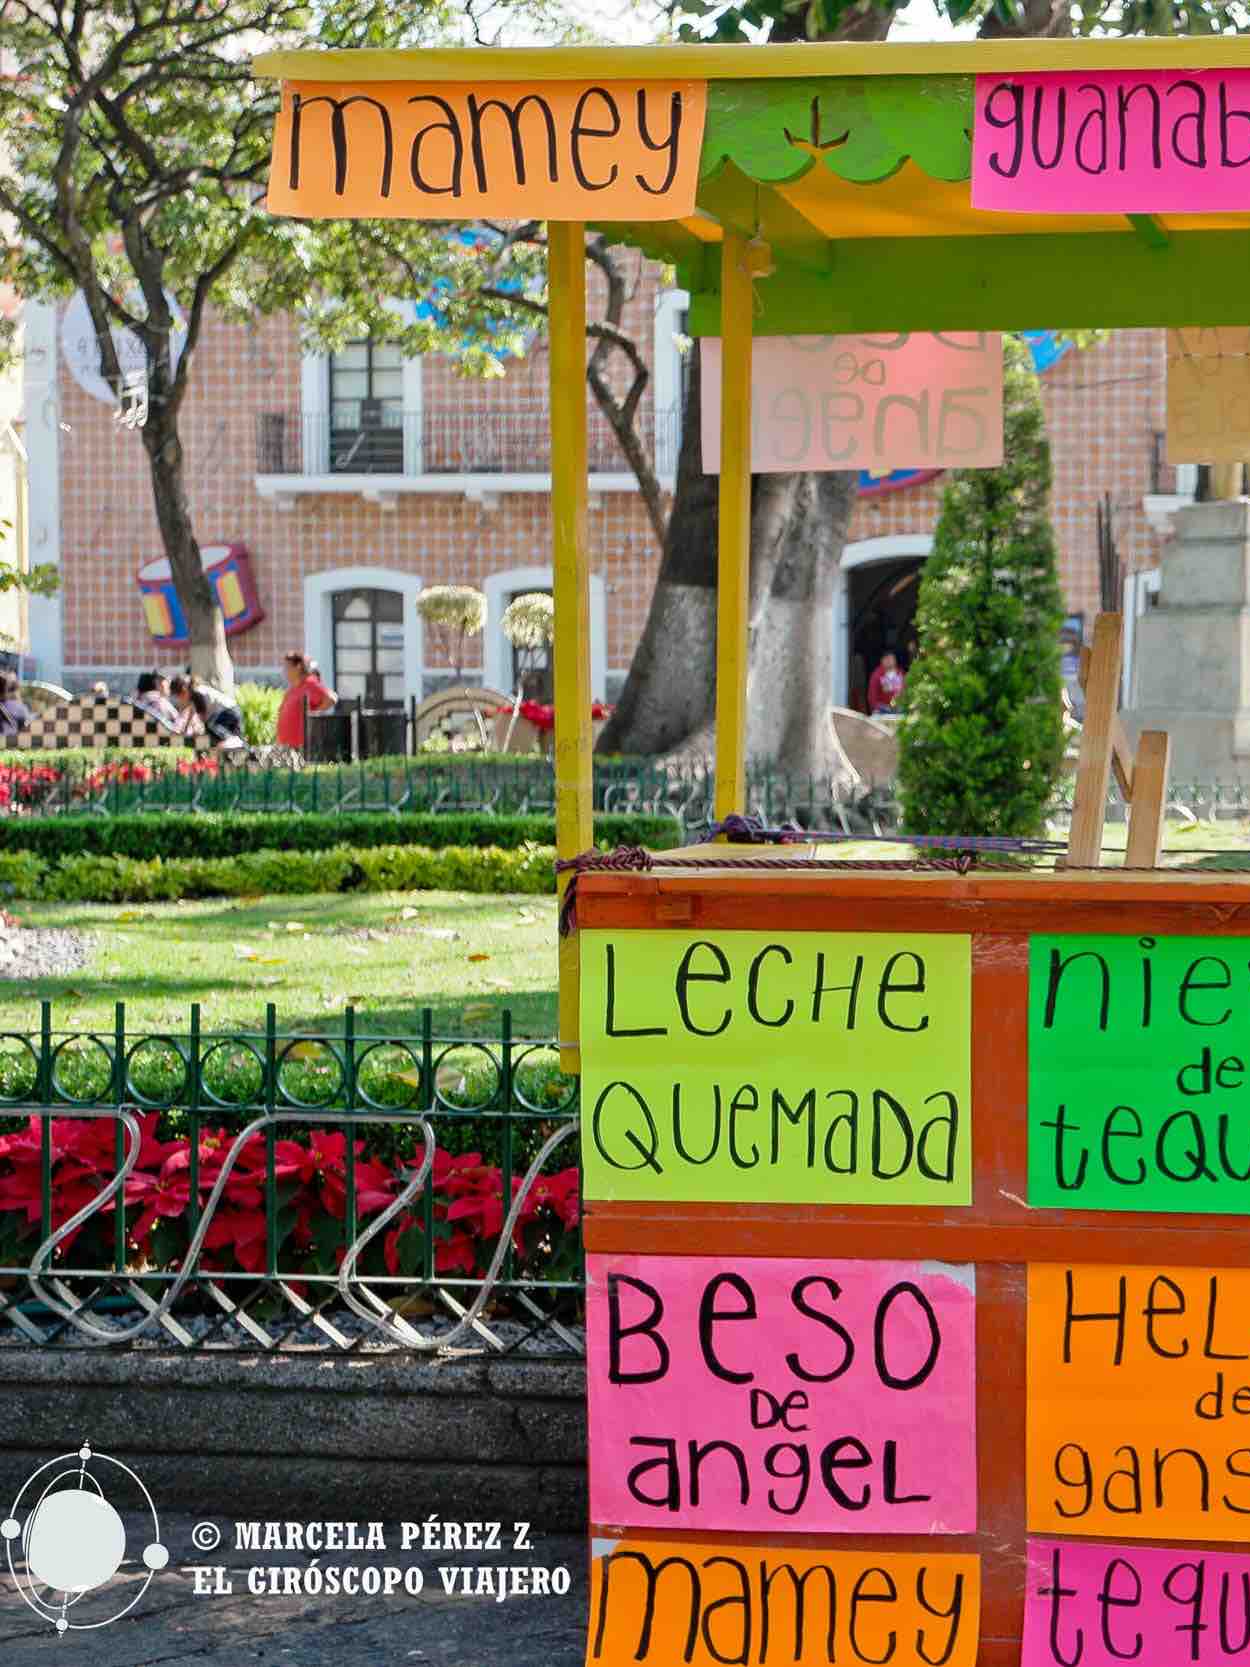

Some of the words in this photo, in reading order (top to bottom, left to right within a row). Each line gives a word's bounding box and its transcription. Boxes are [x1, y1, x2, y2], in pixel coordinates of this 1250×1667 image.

[290, 87, 681, 197] mamey
[1177, 1047, 1244, 1095] de
[594, 1551, 963, 1666] mamey
